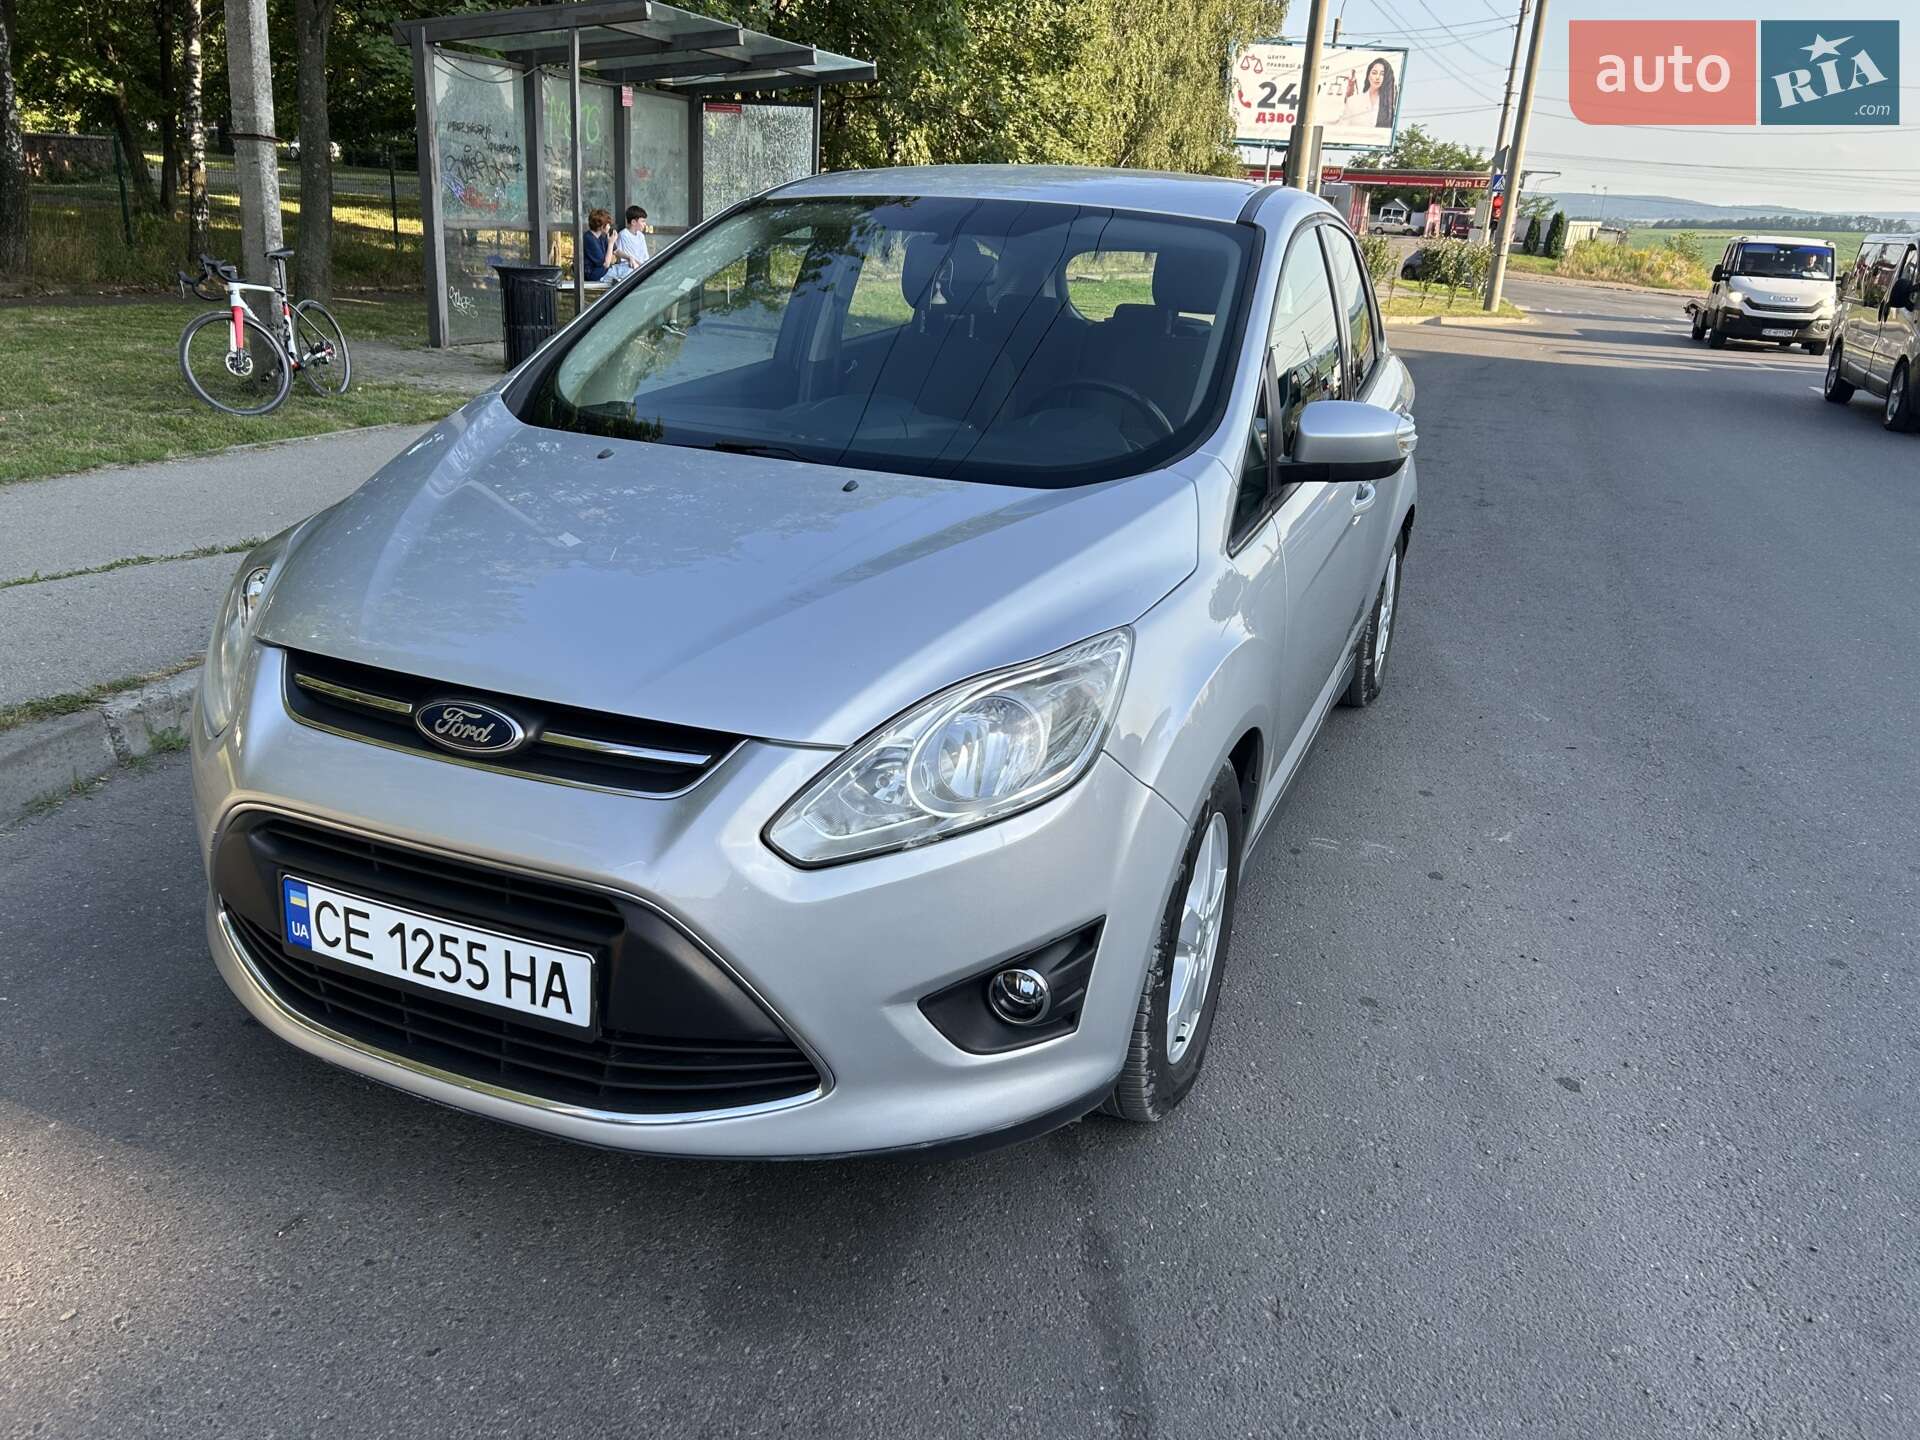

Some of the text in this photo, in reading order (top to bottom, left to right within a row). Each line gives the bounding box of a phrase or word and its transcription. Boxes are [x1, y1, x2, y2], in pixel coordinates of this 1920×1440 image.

[1257, 81, 1299, 110] 24
[1255, 112, 1295, 124] ДЗВО
[1445, 179, 1472, 188] Wash
[435, 707, 496, 742] Ford
[291, 921, 309, 939] UA
[314, 900, 573, 1015] CE 1255 HA
